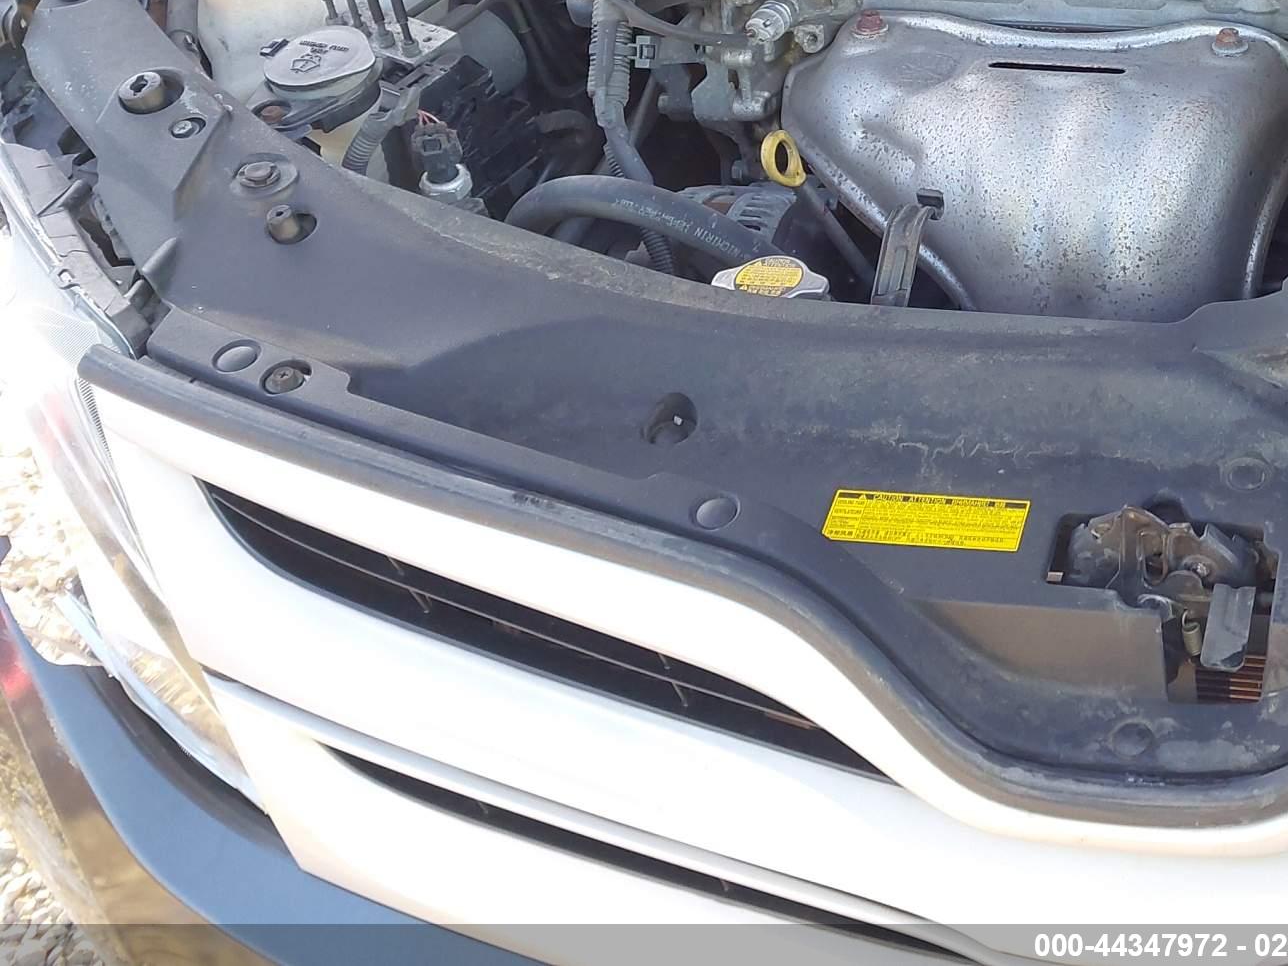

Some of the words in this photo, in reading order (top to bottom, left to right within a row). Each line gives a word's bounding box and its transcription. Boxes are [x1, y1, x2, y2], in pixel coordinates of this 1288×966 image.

[693, 225, 742, 258] NICHIRIN
[873, 493, 904, 503] CAUTION
[908, 495, 947, 505] ATTENTION
